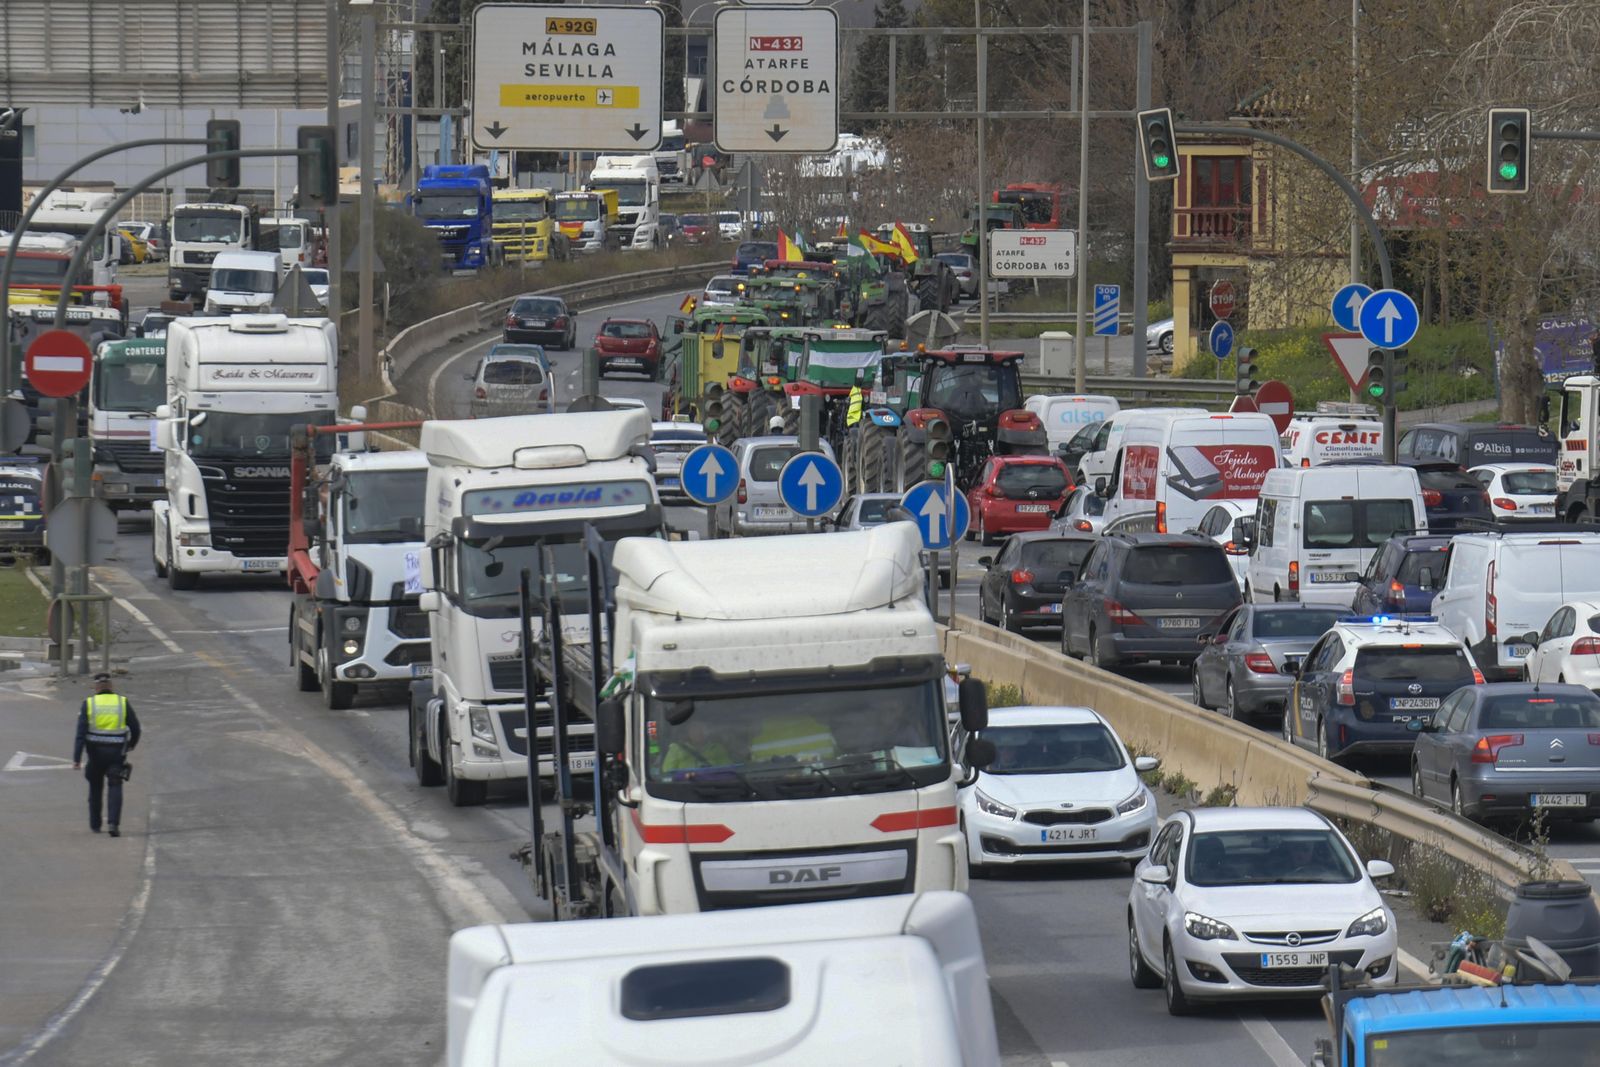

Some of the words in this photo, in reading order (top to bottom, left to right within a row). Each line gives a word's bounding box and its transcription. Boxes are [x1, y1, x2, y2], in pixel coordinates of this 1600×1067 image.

[548, 20, 595, 33] A-92G
[522, 37, 616, 57] MÁLAGA
[751, 38, 802, 50] N-432
[745, 58, 809, 69] ATARFE
[524, 63, 614, 79] SEVILLA
[722, 75, 830, 94] CÓRDOBA
[525, 93, 586, 104] aeropuerto
[1020, 237, 1046, 245] N-432
[996, 259, 1047, 270] CÓRDOBA
[1054, 262, 1070, 270] 163
[1098, 287, 1116, 295] 300
[1212, 294, 1234, 305] STOP
[125, 347, 165, 356] CONTENED
[1060, 410, 1104, 424] alsa
[1315, 432, 1380, 445] CENIT
[1484, 443, 1512, 454] Albia
[1213, 450, 1258, 470] Tejidos
[234, 467, 290, 478] SCANIA
[1225, 467, 1265, 483] Malagó
[1336, 573, 1345, 581] FZ
[1515, 647, 1532, 656] 300
[1538, 795, 1562, 805] 8442
[1565, 795, 1585, 805] FJL
[1049, 830, 1075, 840] 4214
[1078, 828, 1096, 839] JRT
[769, 866, 841, 884] DAF
[1269, 954, 1299, 966] 1559
[1307, 953, 1326, 965] JNP
